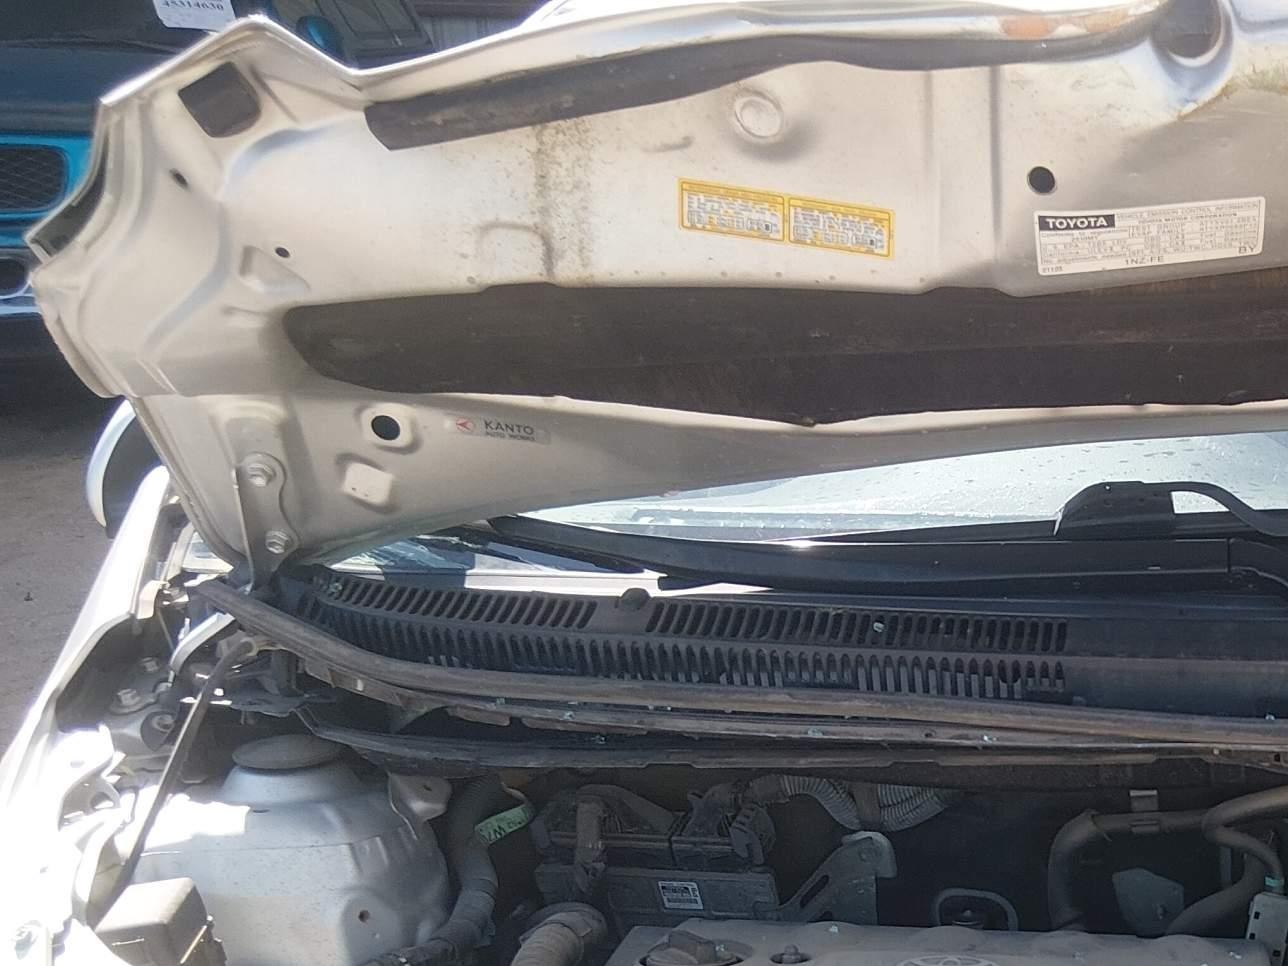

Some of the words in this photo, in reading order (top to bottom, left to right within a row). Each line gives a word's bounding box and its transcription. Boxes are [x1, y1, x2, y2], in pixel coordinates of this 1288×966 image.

[1045, 217, 1108, 229] TOYOTA
[1238, 245, 1255, 253] BY
[1124, 255, 1165, 265] 1NZ-FE
[483, 419, 536, 435] KANTO
